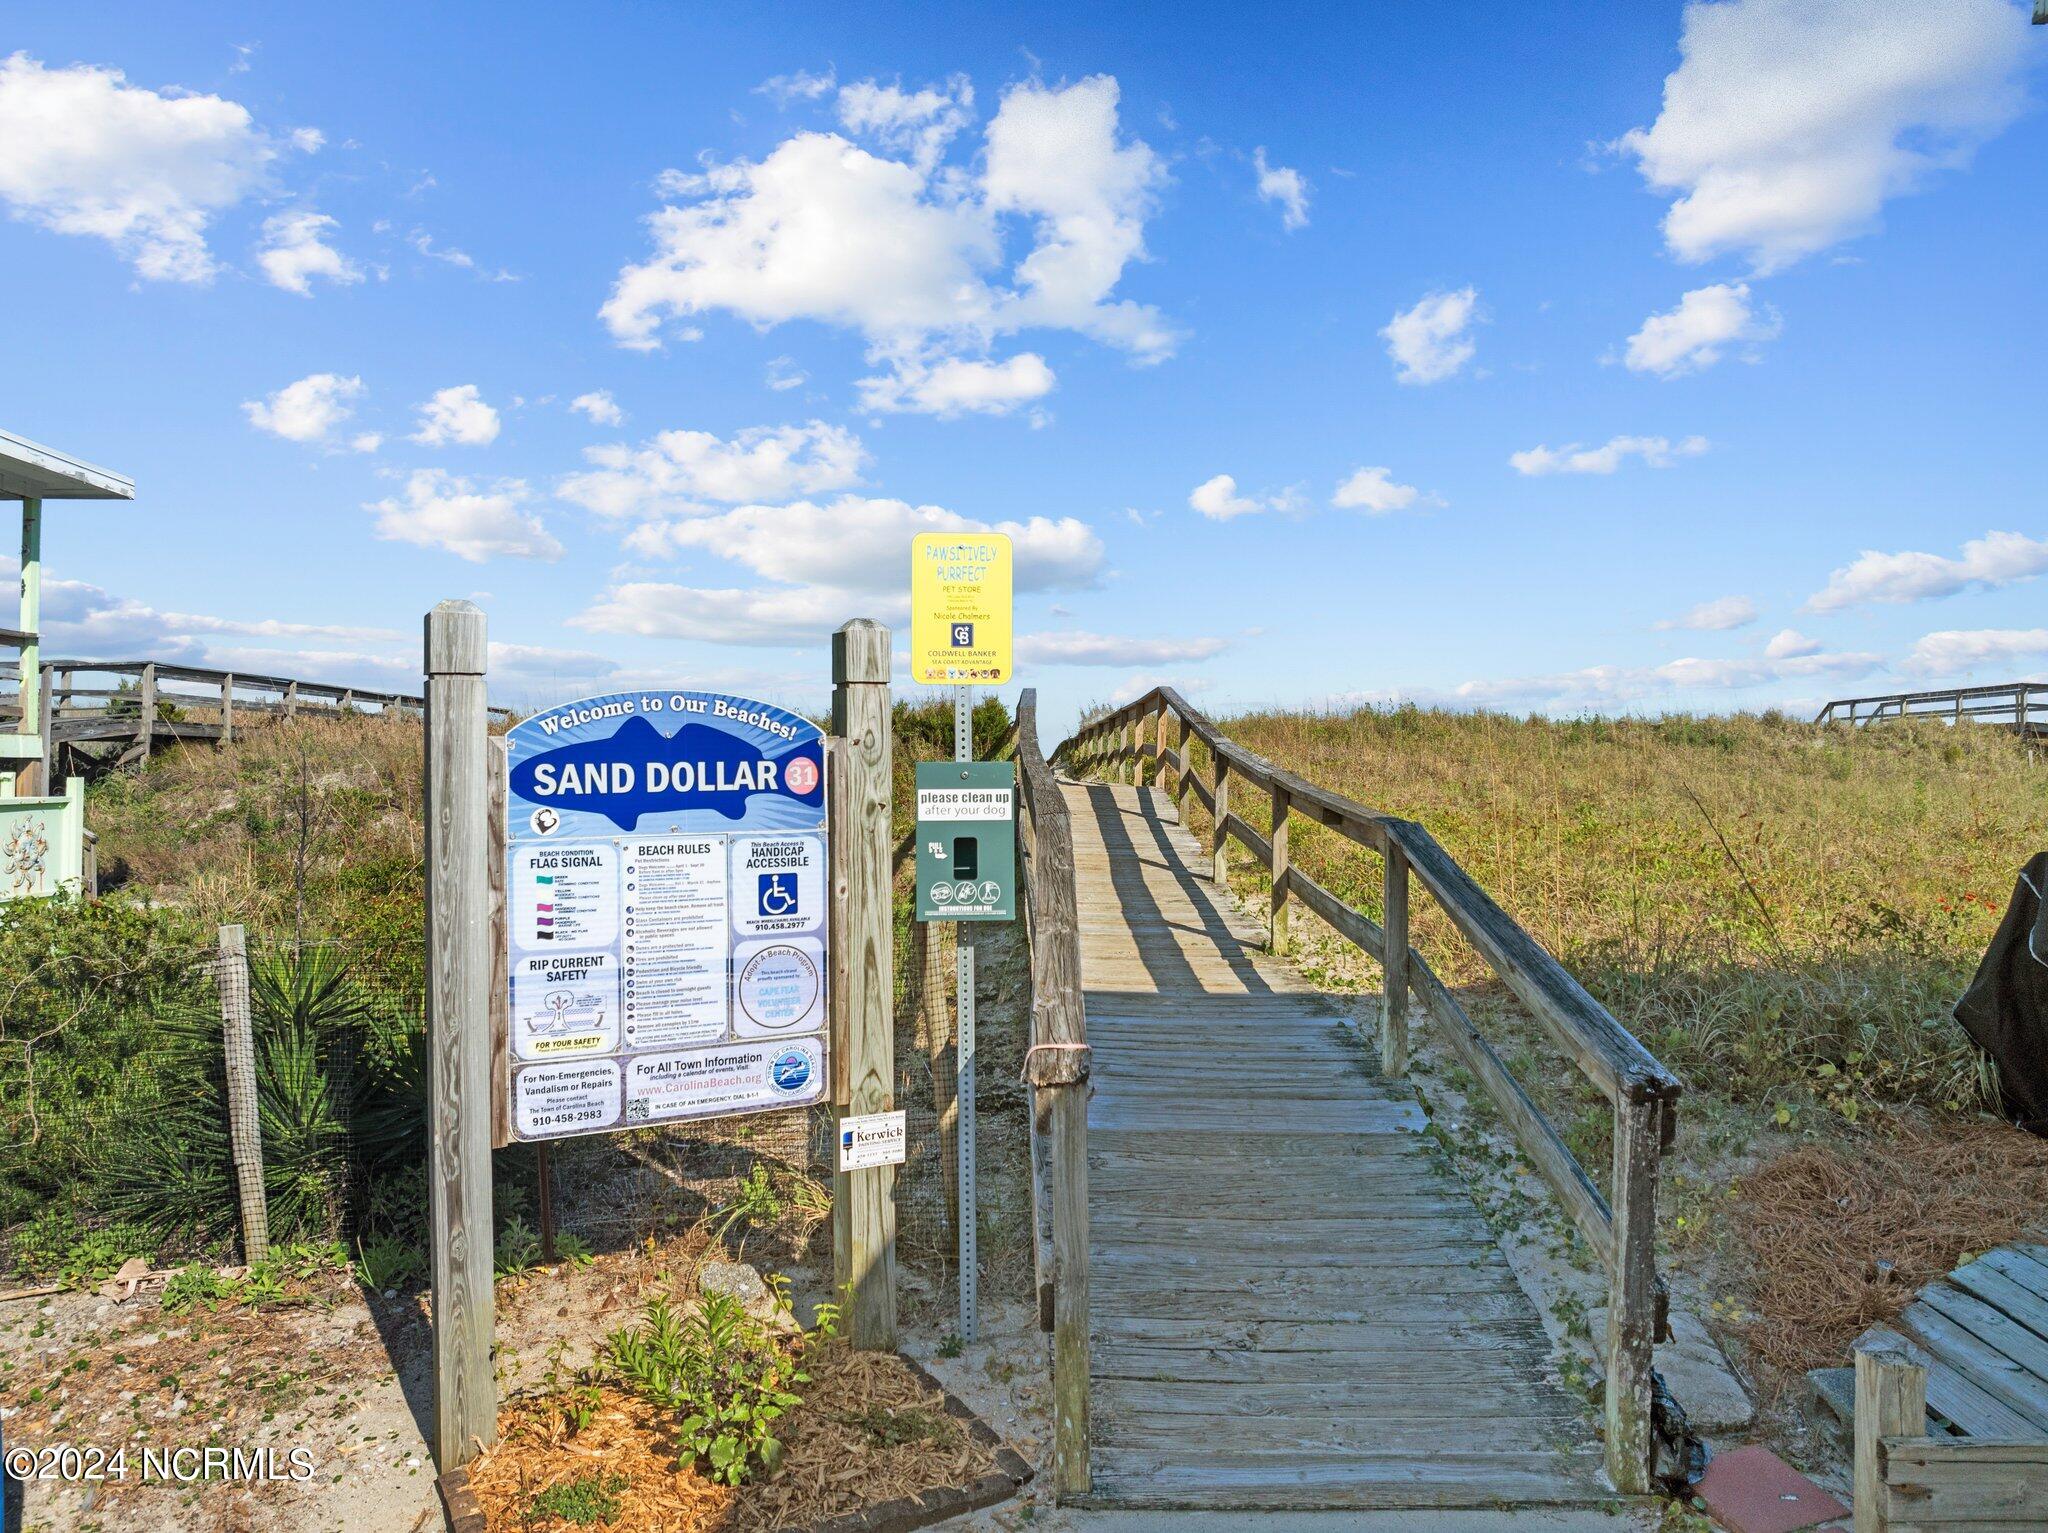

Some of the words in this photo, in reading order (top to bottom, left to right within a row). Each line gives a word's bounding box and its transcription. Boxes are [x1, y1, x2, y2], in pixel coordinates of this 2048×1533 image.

[926, 545, 997, 562] PAWSITIVELY
[937, 566, 987, 581] PURRFECT
[538, 699, 635, 735] Welcome
[641, 696, 663, 711] to
[670, 695, 708, 713] Our
[713, 700, 797, 741] Beaches!
[533, 762, 635, 796] SAND
[646, 760, 778, 793] DOLLAR
[789, 766, 815, 786] 31
[921, 792, 958, 804] please
[962, 792, 992, 803] clean
[996, 793, 1009, 804] up
[925, 804, 951, 815] after
[955, 806, 980, 817] your
[983, 804, 1006, 817] dog
[638, 846, 674, 856] BEACH
[678, 844, 711, 854] RULES
[752, 846, 804, 857] HANDICAP
[530, 858, 558, 868] FLAG
[562, 857, 603, 867] SIGNAL
[746, 857, 809, 868] ACCESSIBLE
[756, 922, 805, 931] 910.458.2977
[530, 960, 549, 970] RIP
[552, 956, 604, 969] CURRENT
[792, 952, 813, 976] Program
[547, 969, 588, 982] SAFETY
[574, 1037, 601, 1045] SAFETY
[637, 1064, 655, 1075] For
[658, 1061, 671, 1073] All
[675, 1060, 702, 1071] Town
[705, 1053, 763, 1064] Information
[539, 1068, 614, 1082] Non-Emergencies,
[650, 1073, 676, 1081] including
[525, 1084, 569, 1095] Vandalism
[581, 1080, 613, 1090] Repairs
[637, 1073, 762, 1096] www.CarolinaBeach.org
[587, 1100, 604, 1108] Beach
[532, 1110, 602, 1126] 910-458-2983
[857, 1126, 903, 1142] Kerwick
